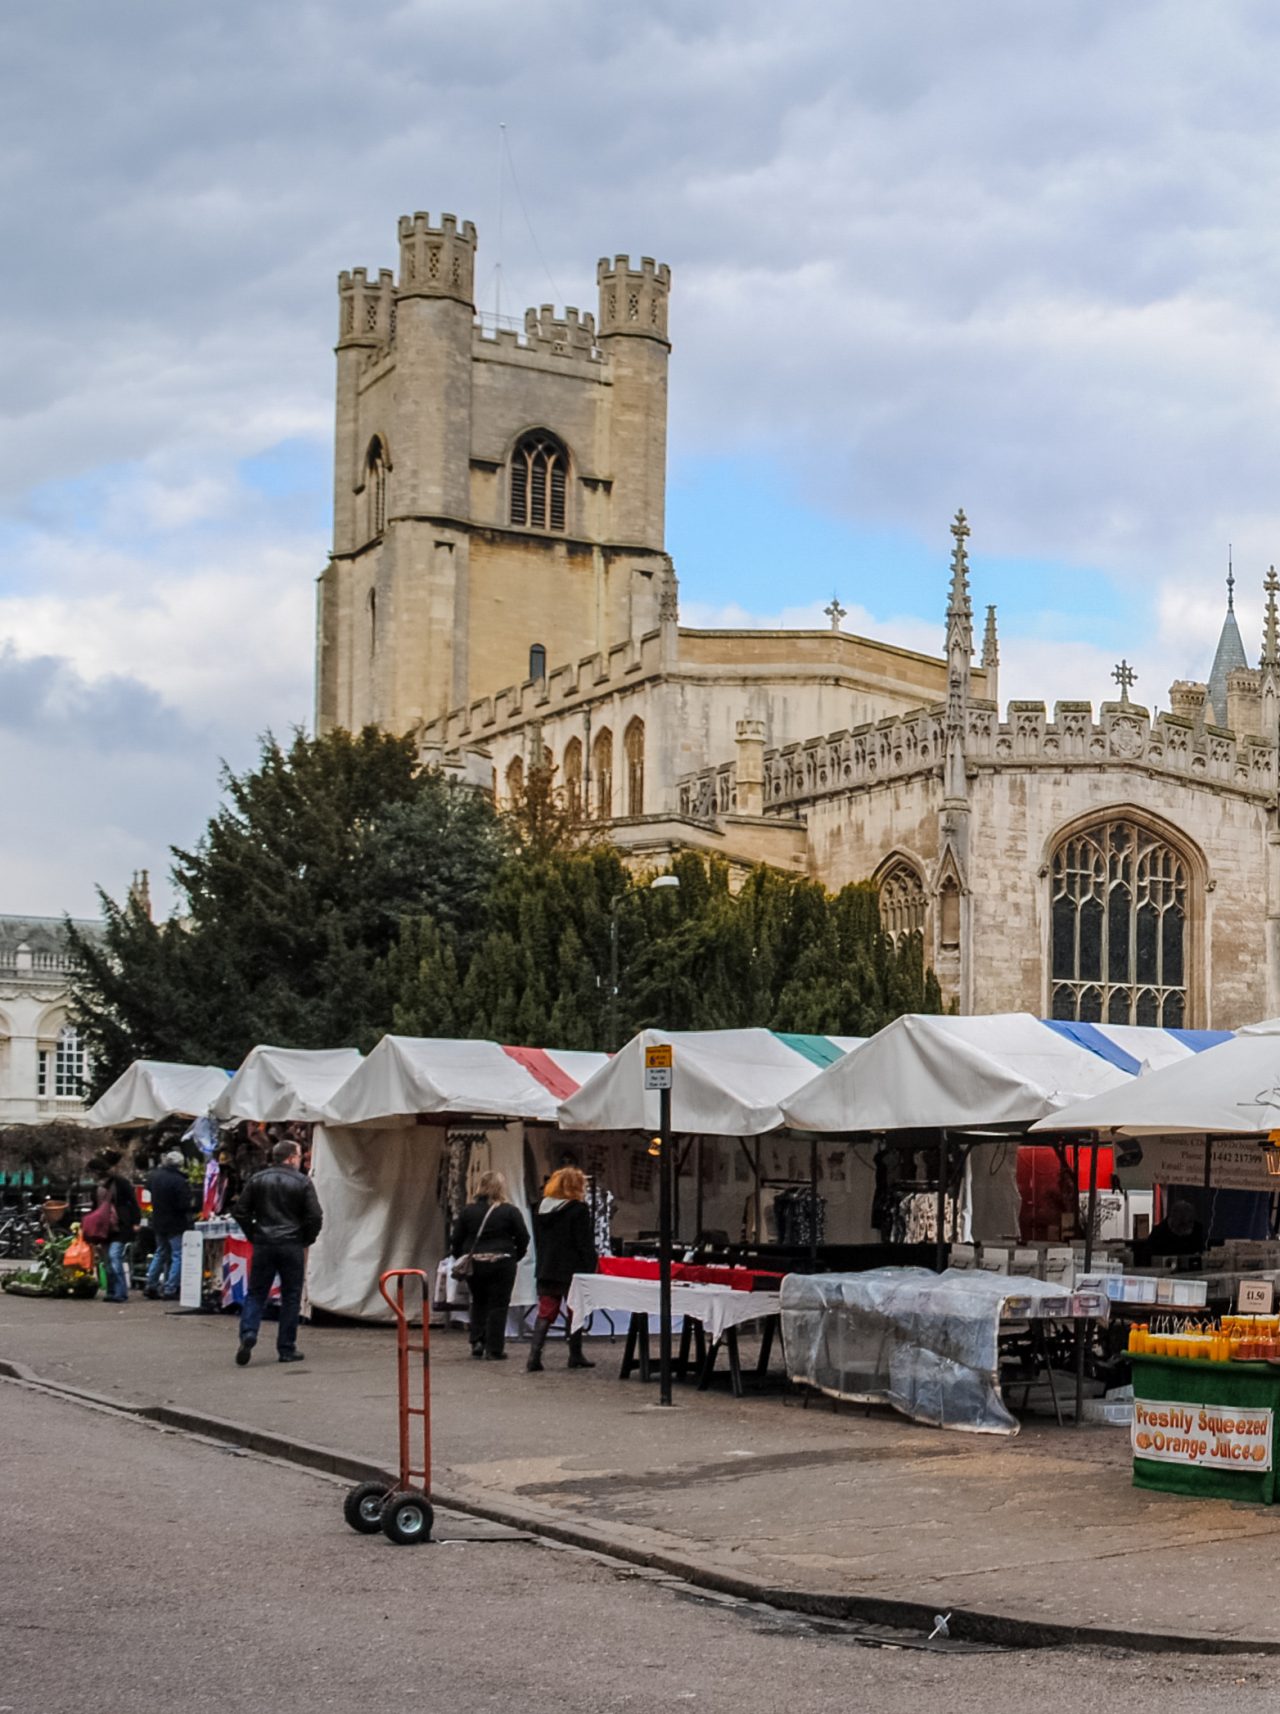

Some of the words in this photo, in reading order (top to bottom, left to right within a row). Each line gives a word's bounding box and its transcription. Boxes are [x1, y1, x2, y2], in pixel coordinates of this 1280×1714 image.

[1210, 1151, 1232, 1162] 1442
[1246, 1290, 1265, 1302] £1.50
[1136, 1404, 1193, 1434] Freshly
[1198, 1410, 1268, 1437] Squeezed
[1153, 1431, 1207, 1459] Orange
[1210, 1437, 1251, 1460] Juice
